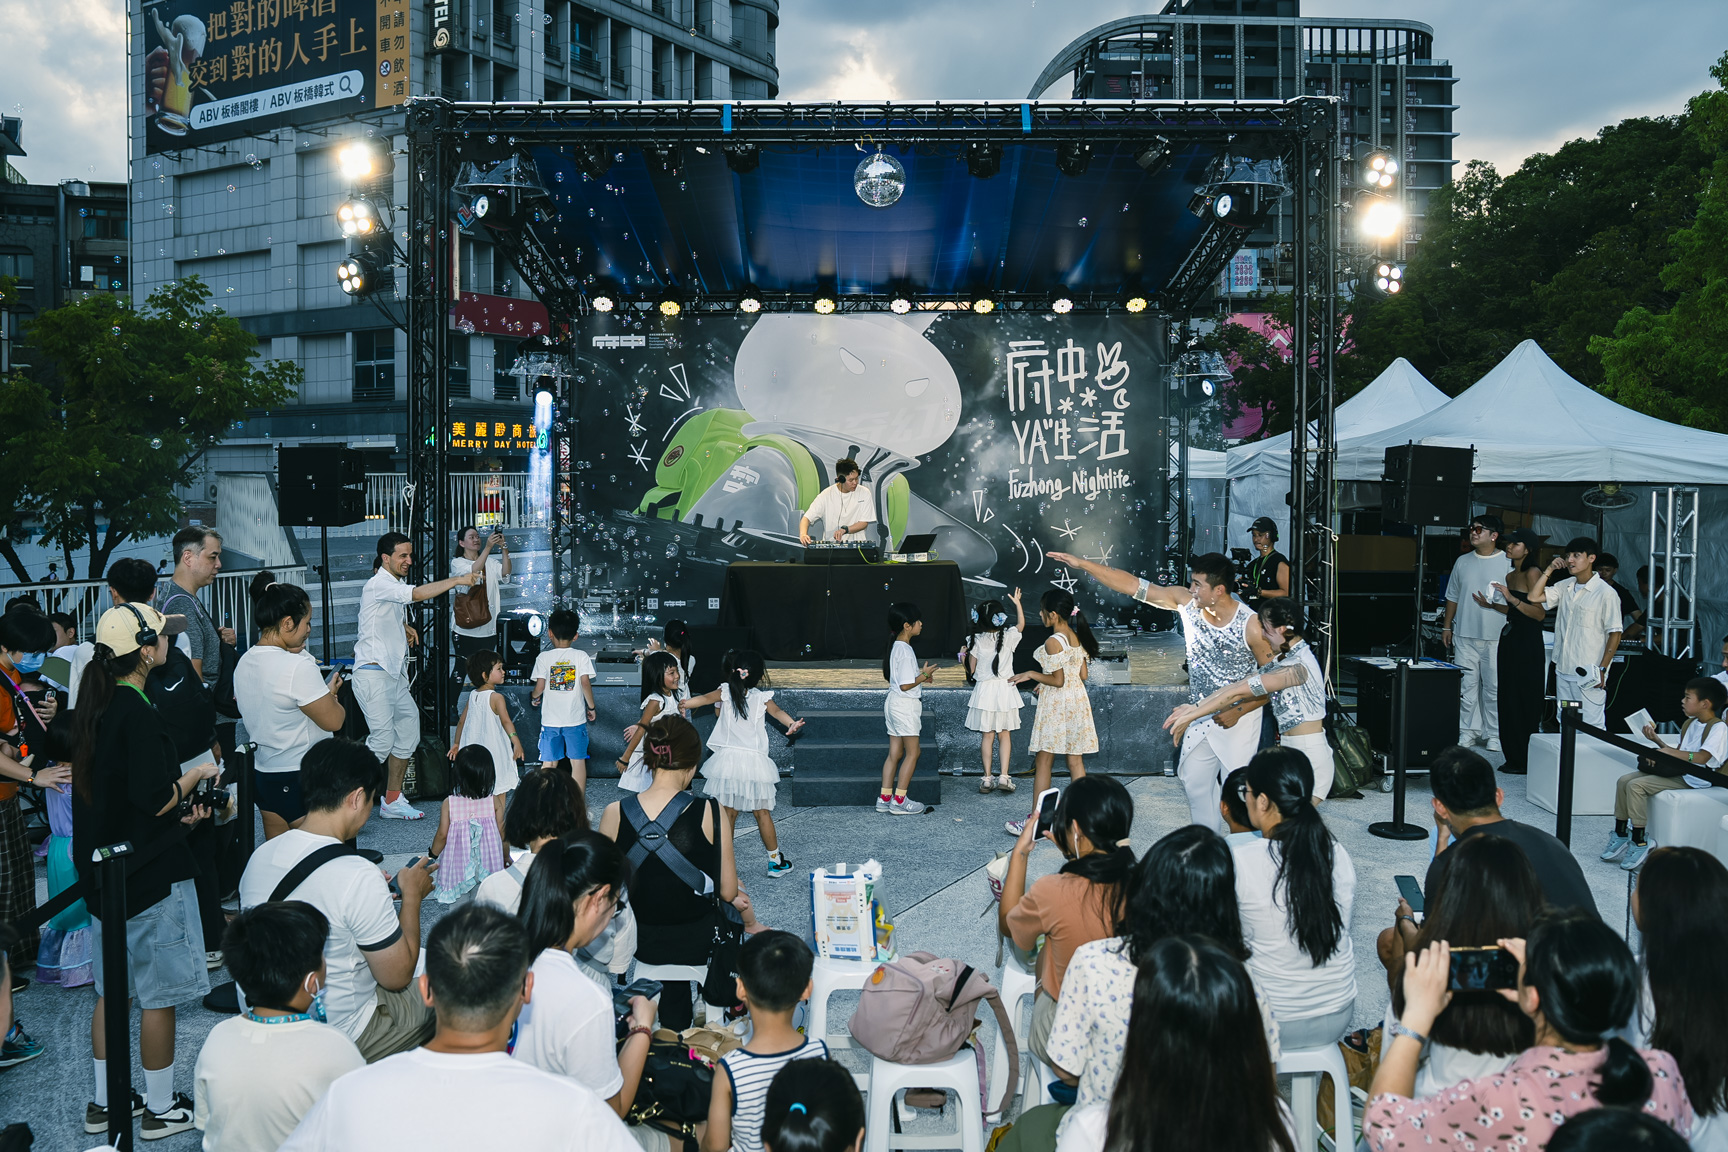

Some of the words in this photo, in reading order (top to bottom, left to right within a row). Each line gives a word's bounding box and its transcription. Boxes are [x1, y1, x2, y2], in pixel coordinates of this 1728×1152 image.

[190, 17, 368, 88] 交到對的人手上
[393, 0, 405, 97] 請勿飲酒
[199, 106, 219, 124] ABV
[270, 91, 292, 109] ABV
[294, 81, 335, 105] 板橋韓式
[452, 421, 537, 438] 美麗殿商旅
[452, 439, 488, 449] MERRY
[494, 440, 511, 449] DAY
[1008, 467, 1071, 500] Fuzhong
[1072, 466, 1131, 500] Nightlife
